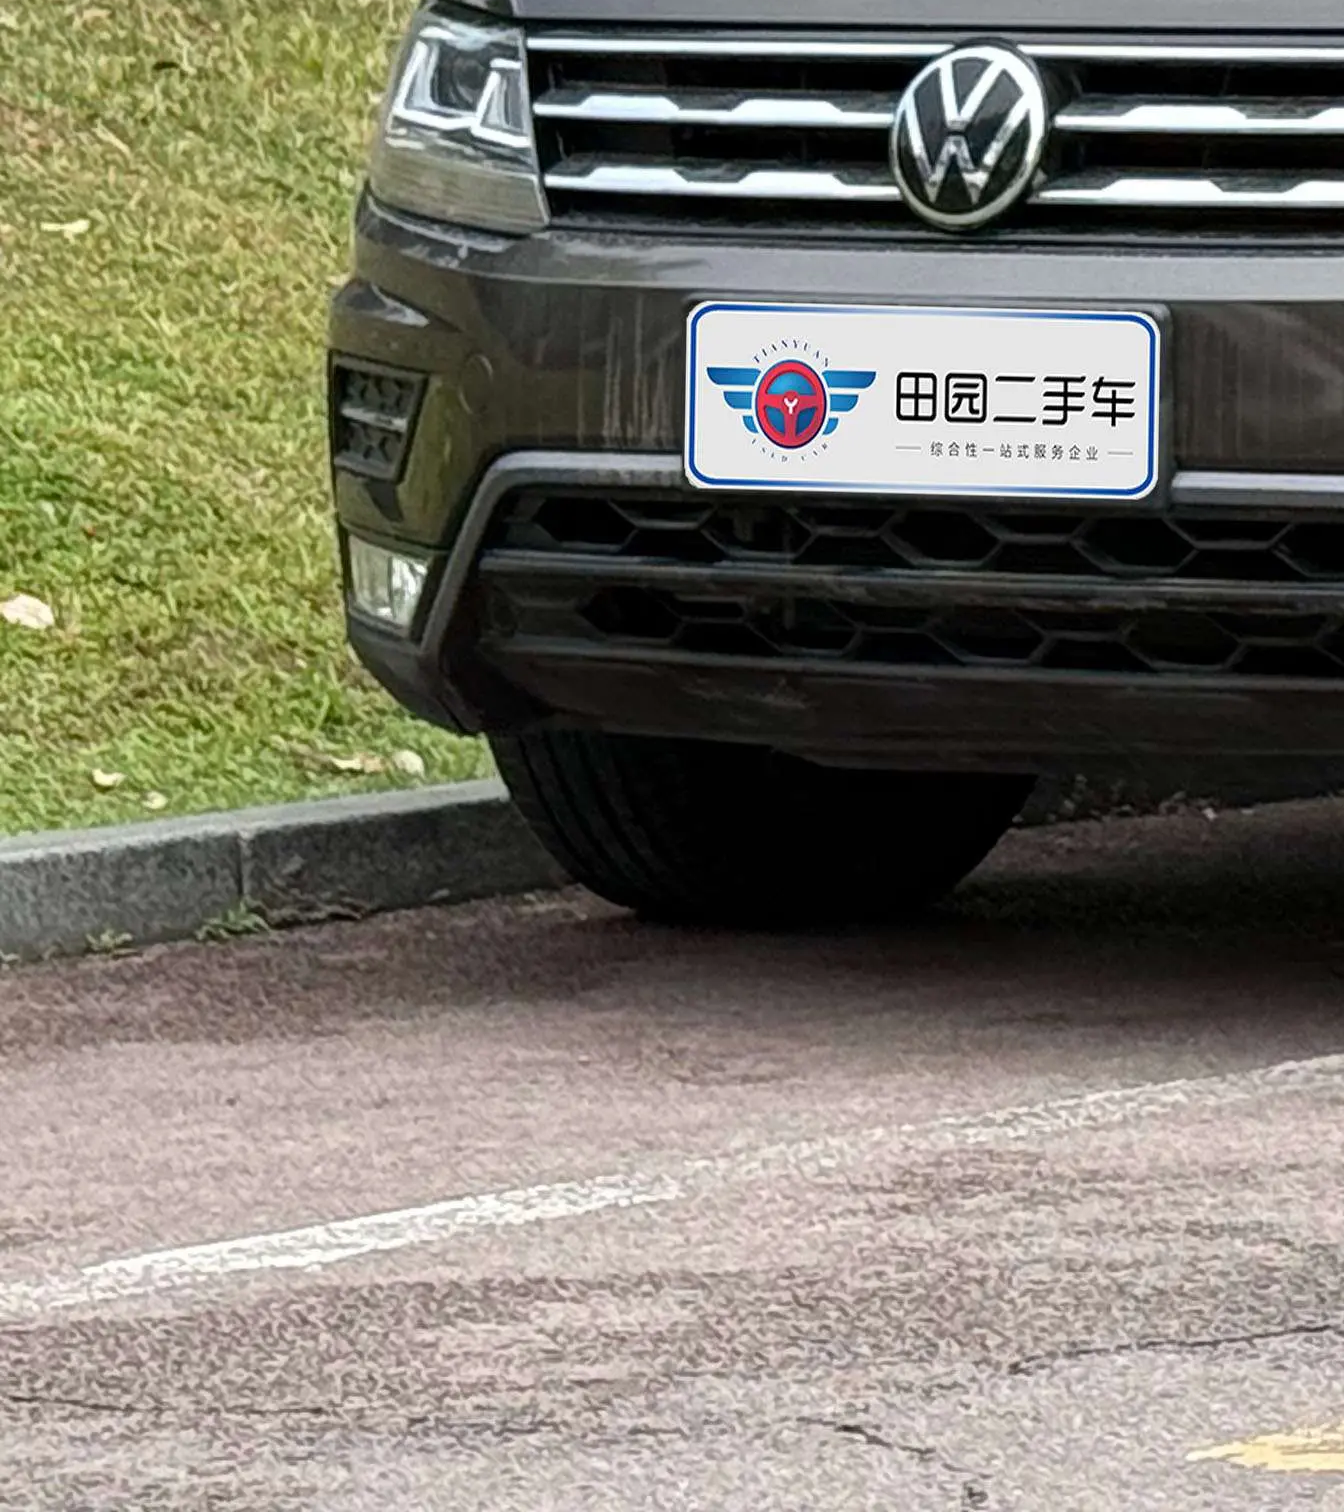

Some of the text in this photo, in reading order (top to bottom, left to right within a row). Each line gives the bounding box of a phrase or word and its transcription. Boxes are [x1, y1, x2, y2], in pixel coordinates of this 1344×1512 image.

[896, 372, 1136, 427] 田园二手车
[929, 440, 1099, 461] 综合性一站式服务企业
